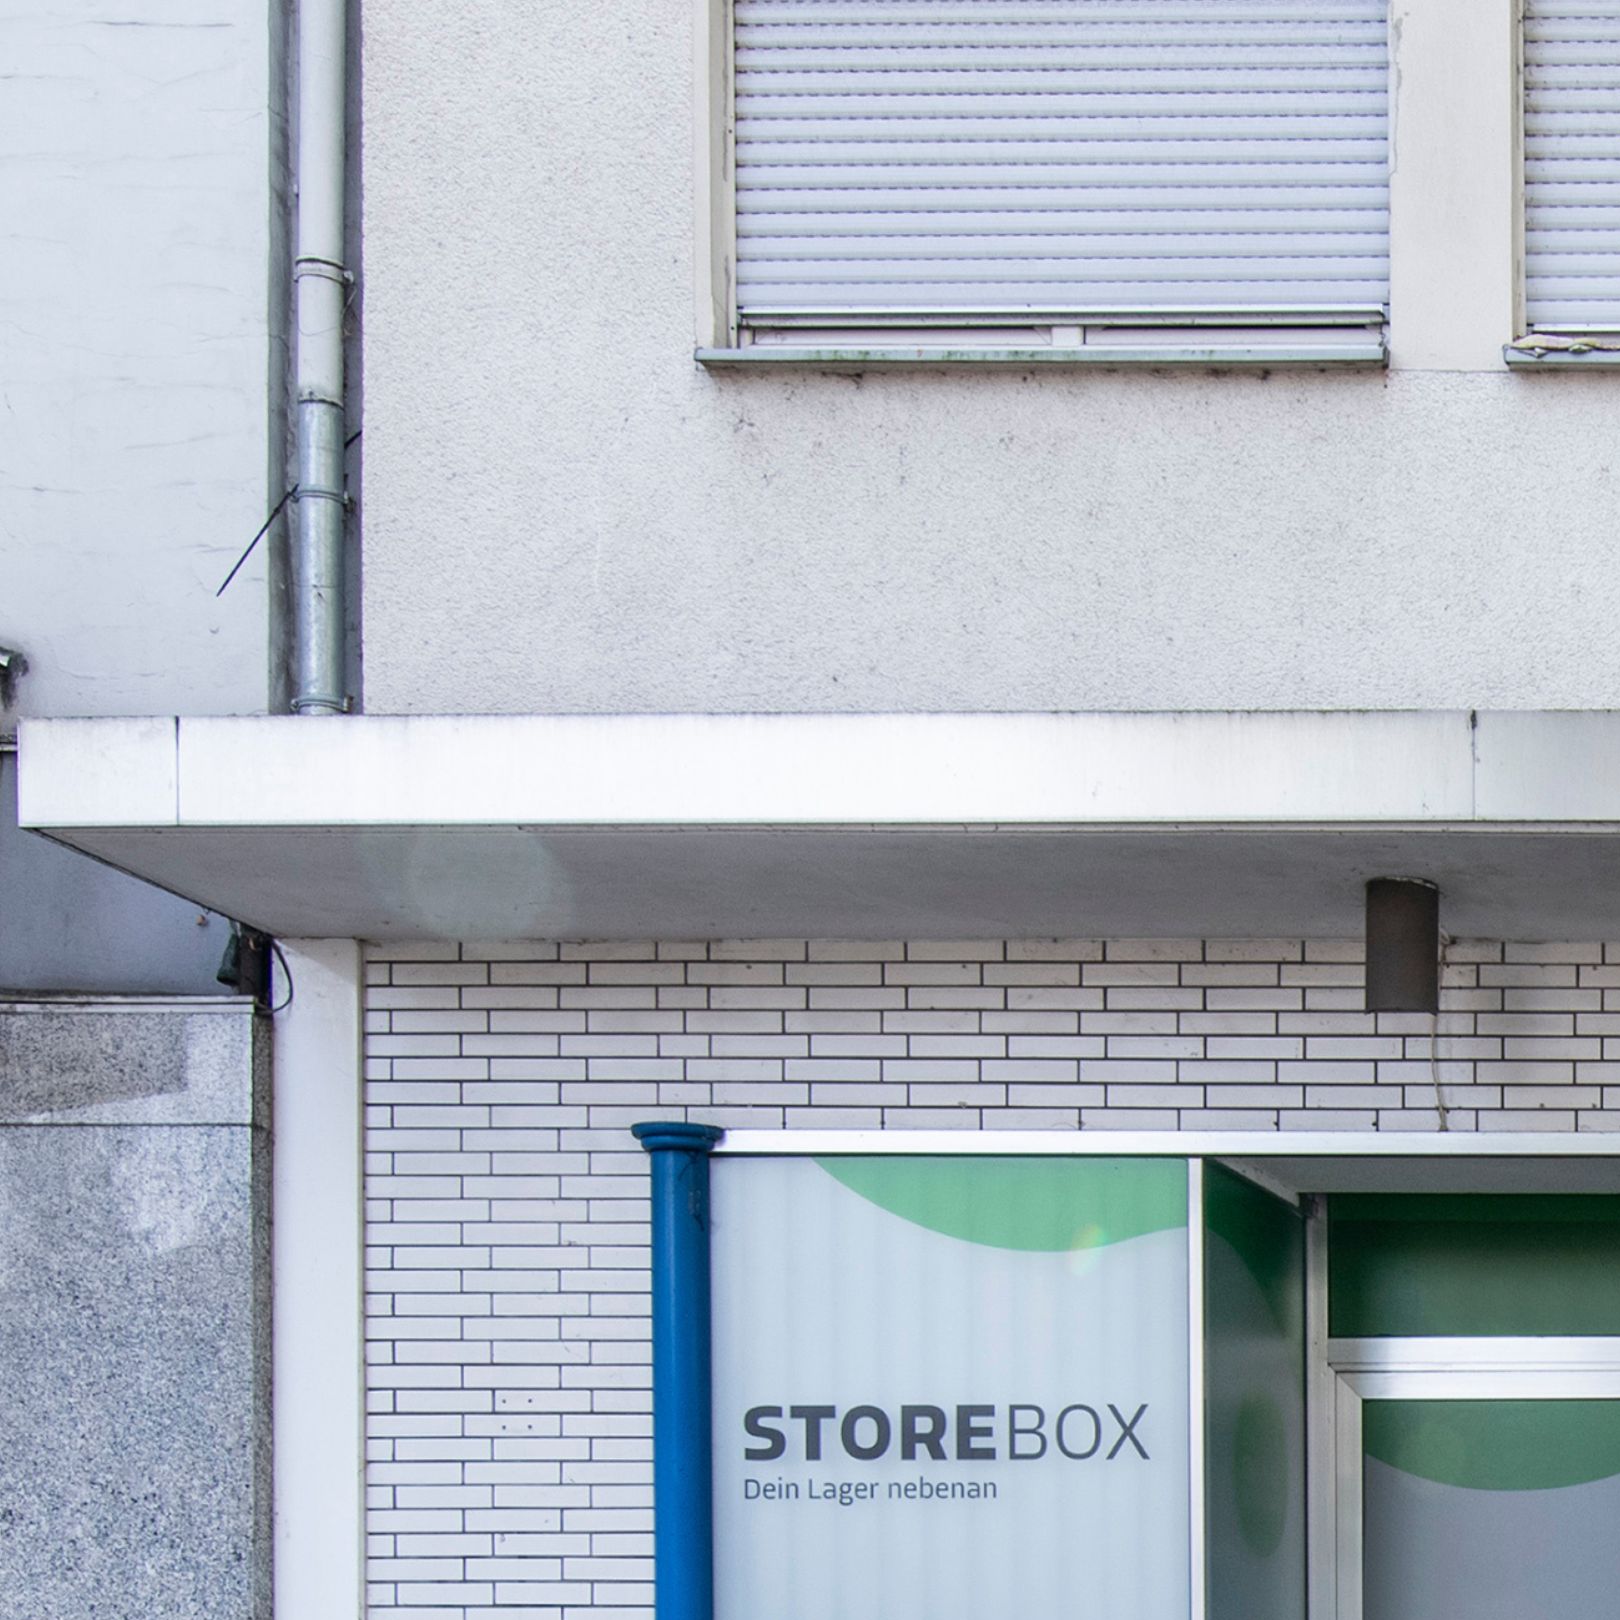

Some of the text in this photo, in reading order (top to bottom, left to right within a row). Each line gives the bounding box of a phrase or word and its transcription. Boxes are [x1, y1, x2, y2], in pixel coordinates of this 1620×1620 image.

[743, 1404, 1151, 1461] STOREBOX
[743, 1476, 997, 1506] Dein Lager nebenan
